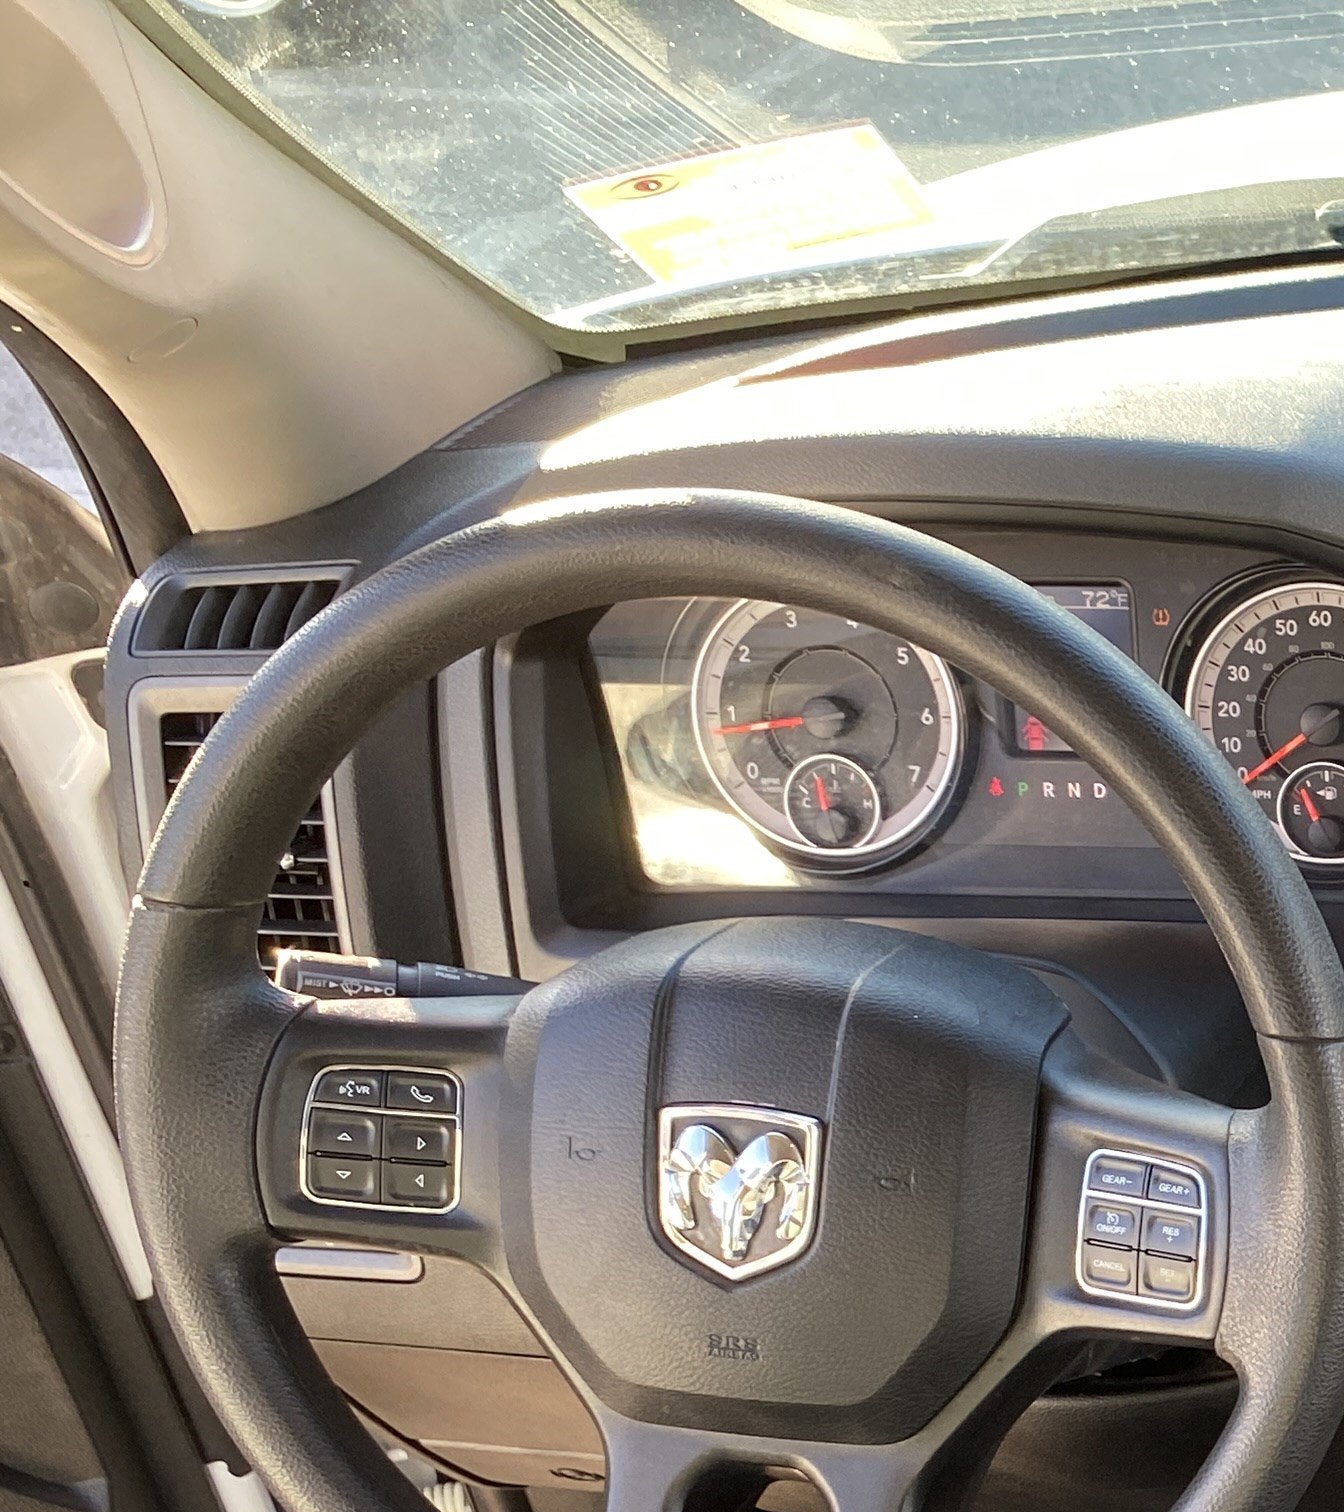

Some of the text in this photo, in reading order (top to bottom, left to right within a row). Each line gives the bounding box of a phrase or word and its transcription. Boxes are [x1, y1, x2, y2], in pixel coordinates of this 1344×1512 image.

[1081, 590, 1129, 608] 72°F
[785, 610, 798, 629] 3
[1308, 610, 1332, 627] 60
[1274, 619, 1298, 636] 50
[738, 646, 751, 663] 2
[1243, 638, 1267, 655] 40
[896, 648, 910, 665] 5
[1226, 665, 1250, 682] 30
[726, 705, 737, 722] 1
[920, 708, 934, 726] 6
[1217, 701, 1241, 718] 20
[1221, 736, 1242, 753] 10
[746, 762, 759, 779] 0
[907, 765, 921, 783] 7
[1018, 782, 1107, 798] P R N D
[863, 799, 873, 809] H
[1293, 804, 1302, 815] E
[304, 978, 328, 989] MIST
[355, 1084, 370, 1095] VR
[1161, 1226, 1180, 1237] RES
